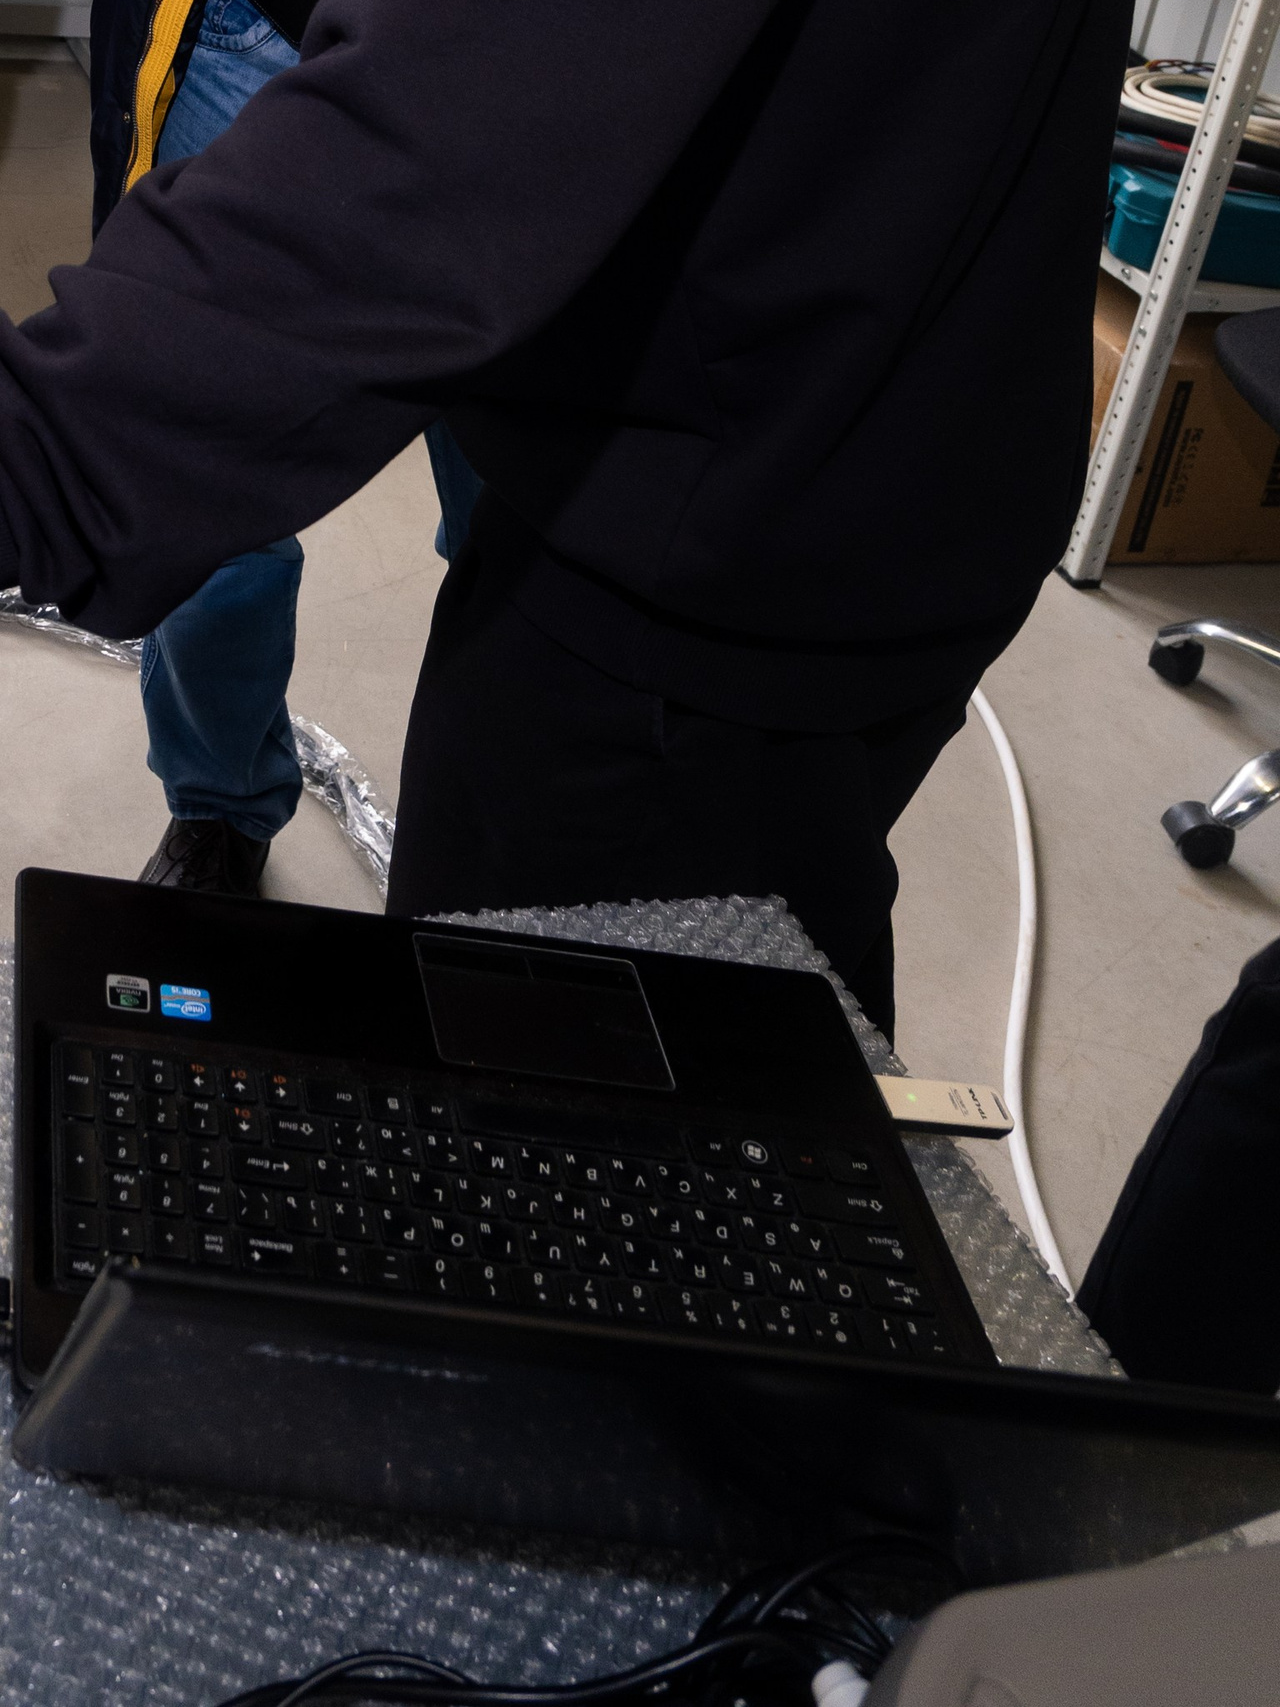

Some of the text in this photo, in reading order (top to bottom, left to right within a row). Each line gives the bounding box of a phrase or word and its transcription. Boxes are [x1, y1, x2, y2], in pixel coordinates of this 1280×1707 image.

[68, 1075, 89, 1084] Enter
[337, 1093, 352, 1101] Ctrl
[194, 1102, 208, 1110] End
[247, 1158, 270, 1168] Enter
[540, 1163, 550, 1174] N
[852, 1162, 867, 1170] Ctrl
[199, 1184, 220, 1193] Home
[435, 1189, 442, 1201] L
[207, 1203, 213, 1213] 7
[848, 1198, 867, 1207] Shift
[622, 1214, 633, 1226] G
[671, 1221, 679, 1232] F
[717, 1226, 727, 1238] D
[249, 1239, 293, 1253] Backspace
[867, 1236, 900, 1248] CapsLk
[585, 1280, 593, 1291] 7
[790, 1279, 804, 1292] W
[839, 1284, 852, 1298] Q
[904, 1287, 920, 1296] Tab
[732, 1300, 740, 1311] 4
[781, 1306, 790, 1318] 3
[830, 1312, 838, 1325] 2
